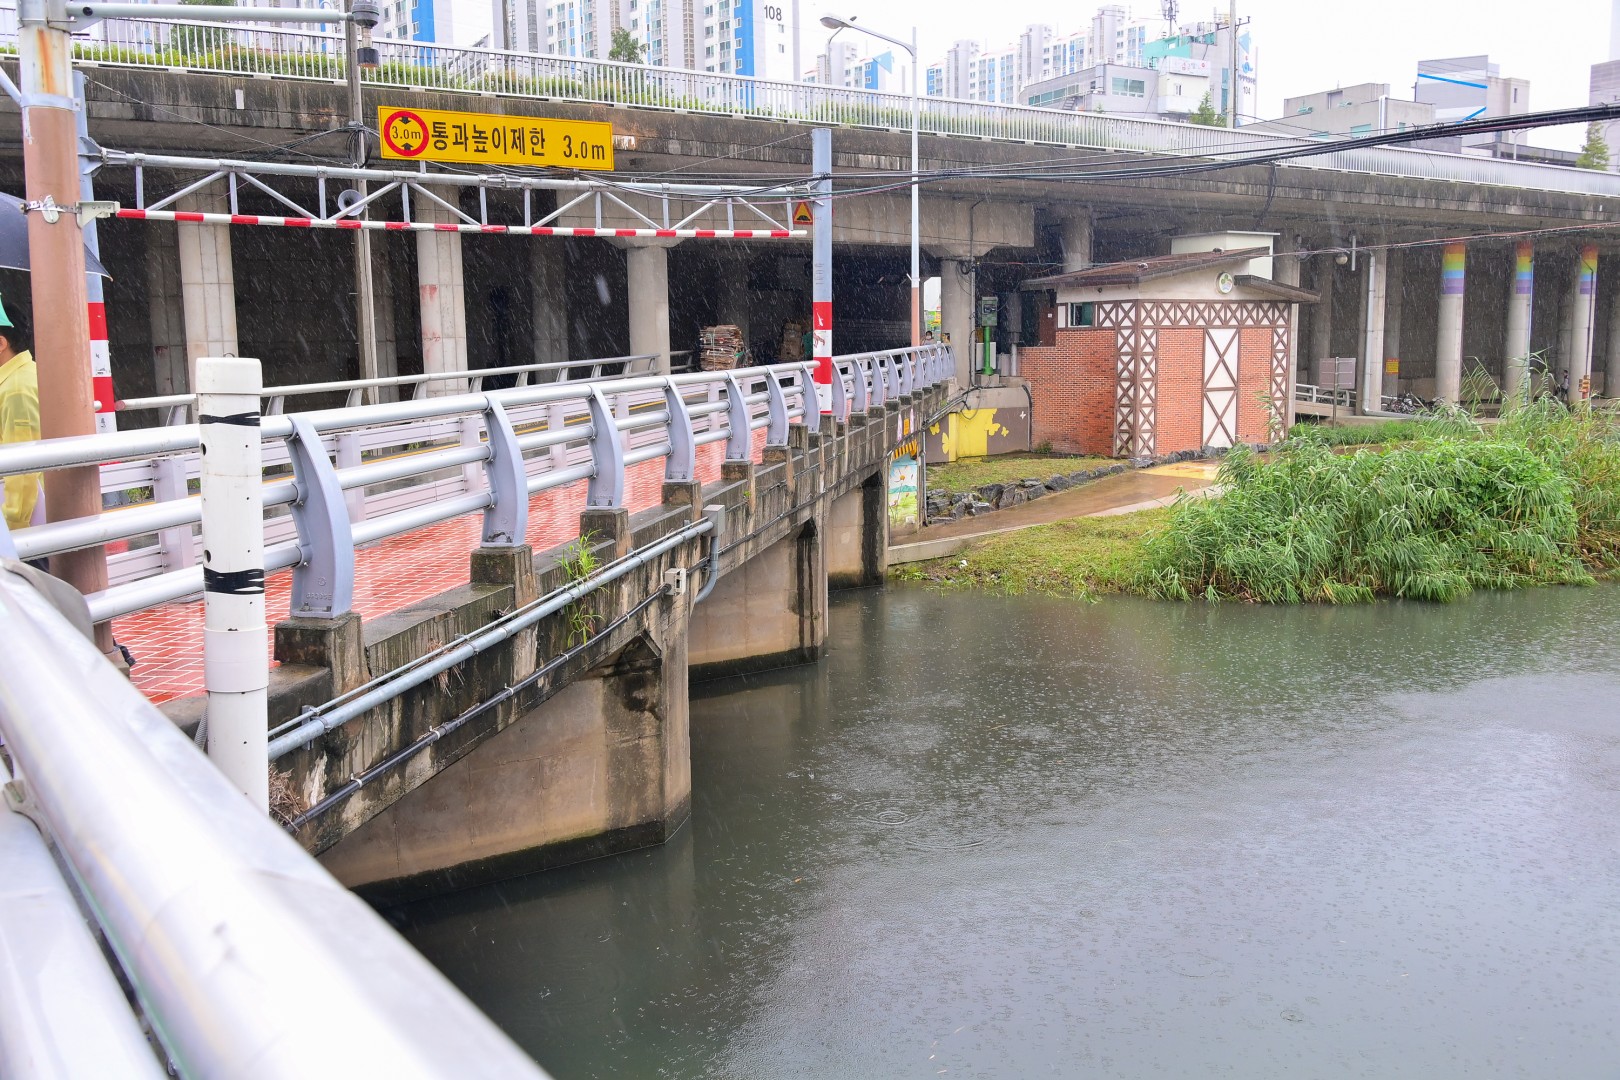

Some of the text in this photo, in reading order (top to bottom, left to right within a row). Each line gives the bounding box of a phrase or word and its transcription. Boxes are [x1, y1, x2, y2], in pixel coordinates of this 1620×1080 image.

[764, 4, 782, 22] 108
[392, 125, 421, 140] 3.0m
[431, 121, 606, 160] 통과높이제한 3.0m
